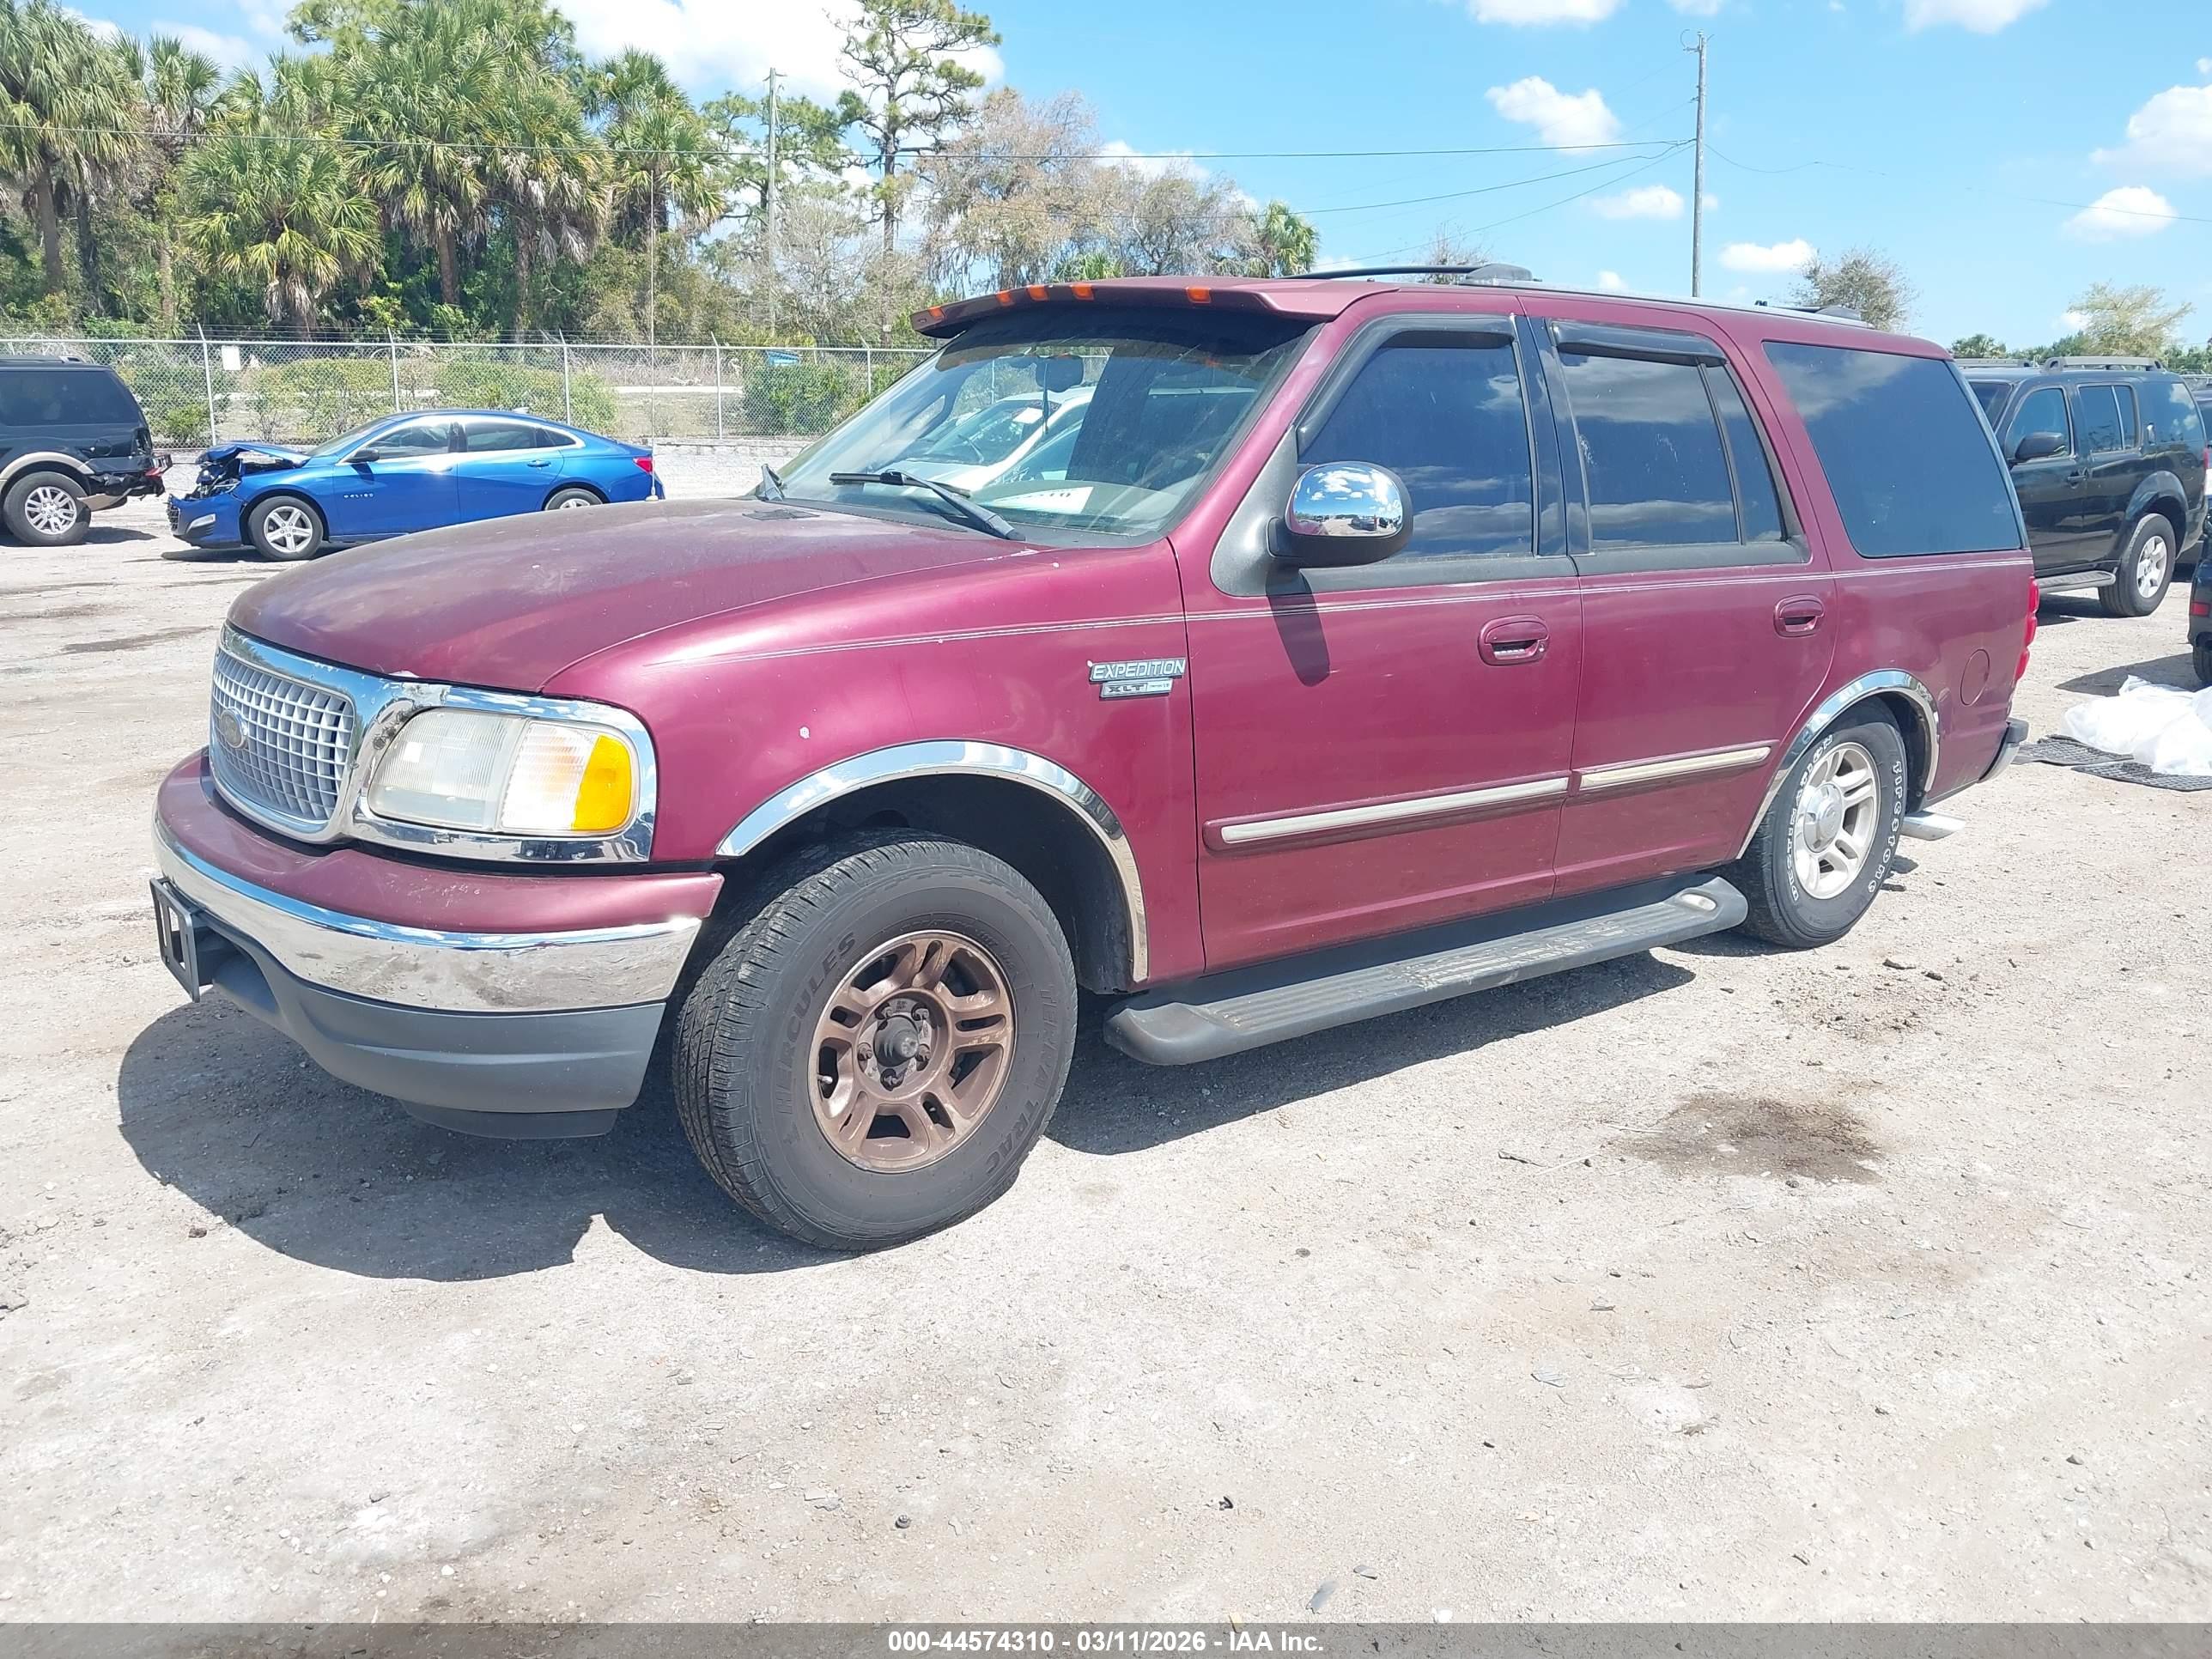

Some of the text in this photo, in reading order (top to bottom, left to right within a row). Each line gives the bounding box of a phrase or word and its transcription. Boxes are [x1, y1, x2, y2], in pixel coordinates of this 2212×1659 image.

[1092, 659, 1185, 679] EXPEDITION
[1109, 684, 1146, 693] XLT
[775, 932, 855, 1115] HERCULES
[987, 1100, 1040, 1174] TRAC
